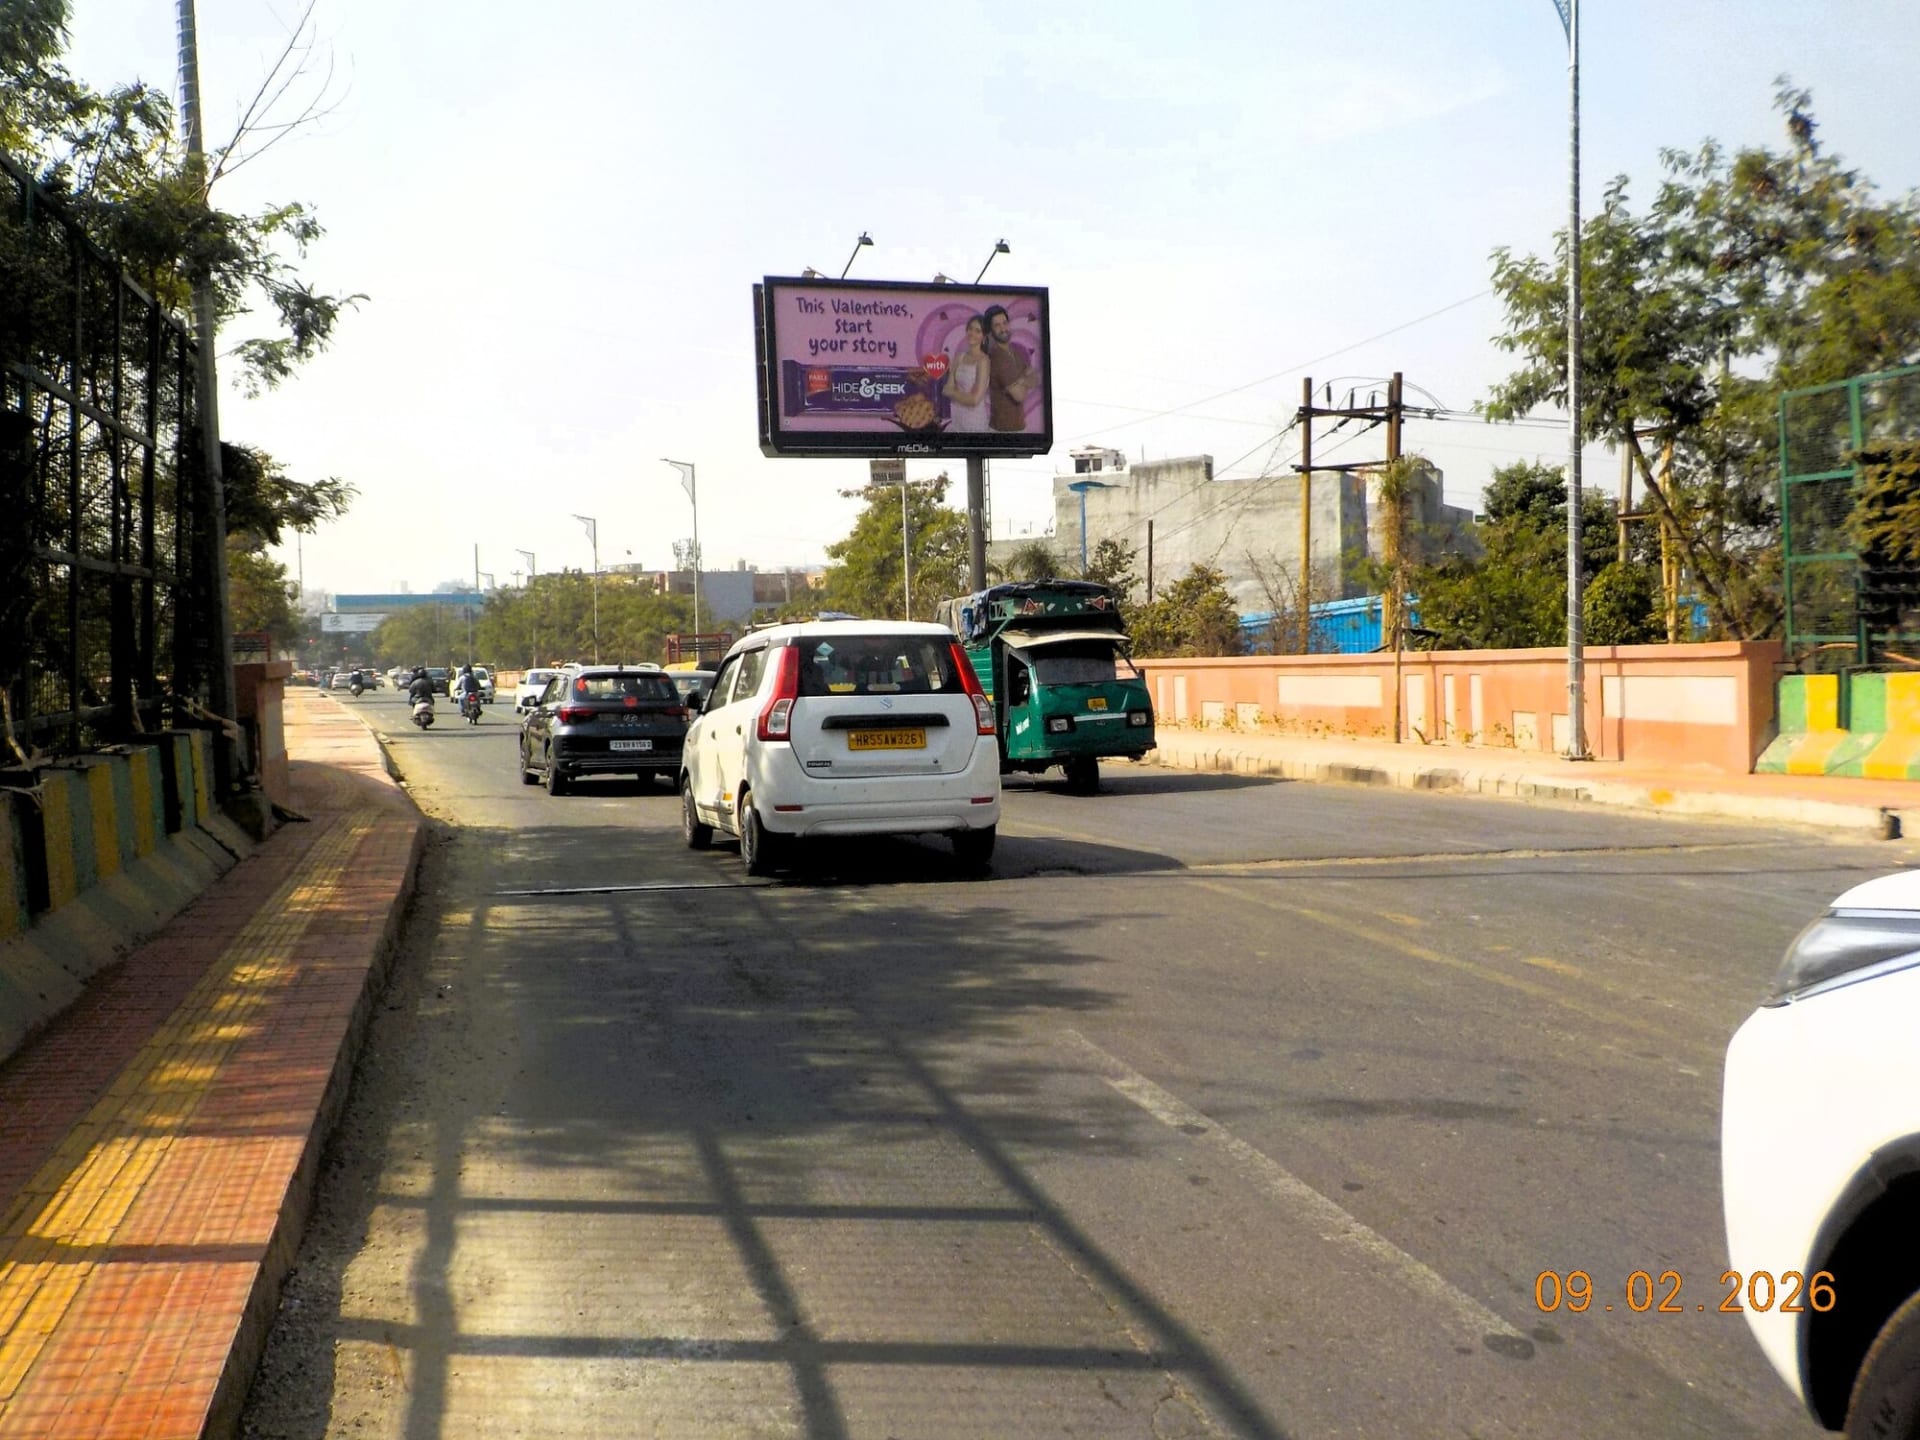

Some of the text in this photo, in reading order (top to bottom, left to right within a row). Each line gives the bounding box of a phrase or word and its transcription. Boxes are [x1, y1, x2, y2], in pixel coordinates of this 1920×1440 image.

[796, 297, 913, 319] This Valentines,
[835, 318, 872, 334] Start
[809, 337, 897, 358] your story
[926, 360, 945, 370] with
[832, 382, 860, 394] HIDE
[859, 377, 876, 398] &
[875, 383, 906, 394] SEEK
[855, 733, 923, 746] HR55AW3261
